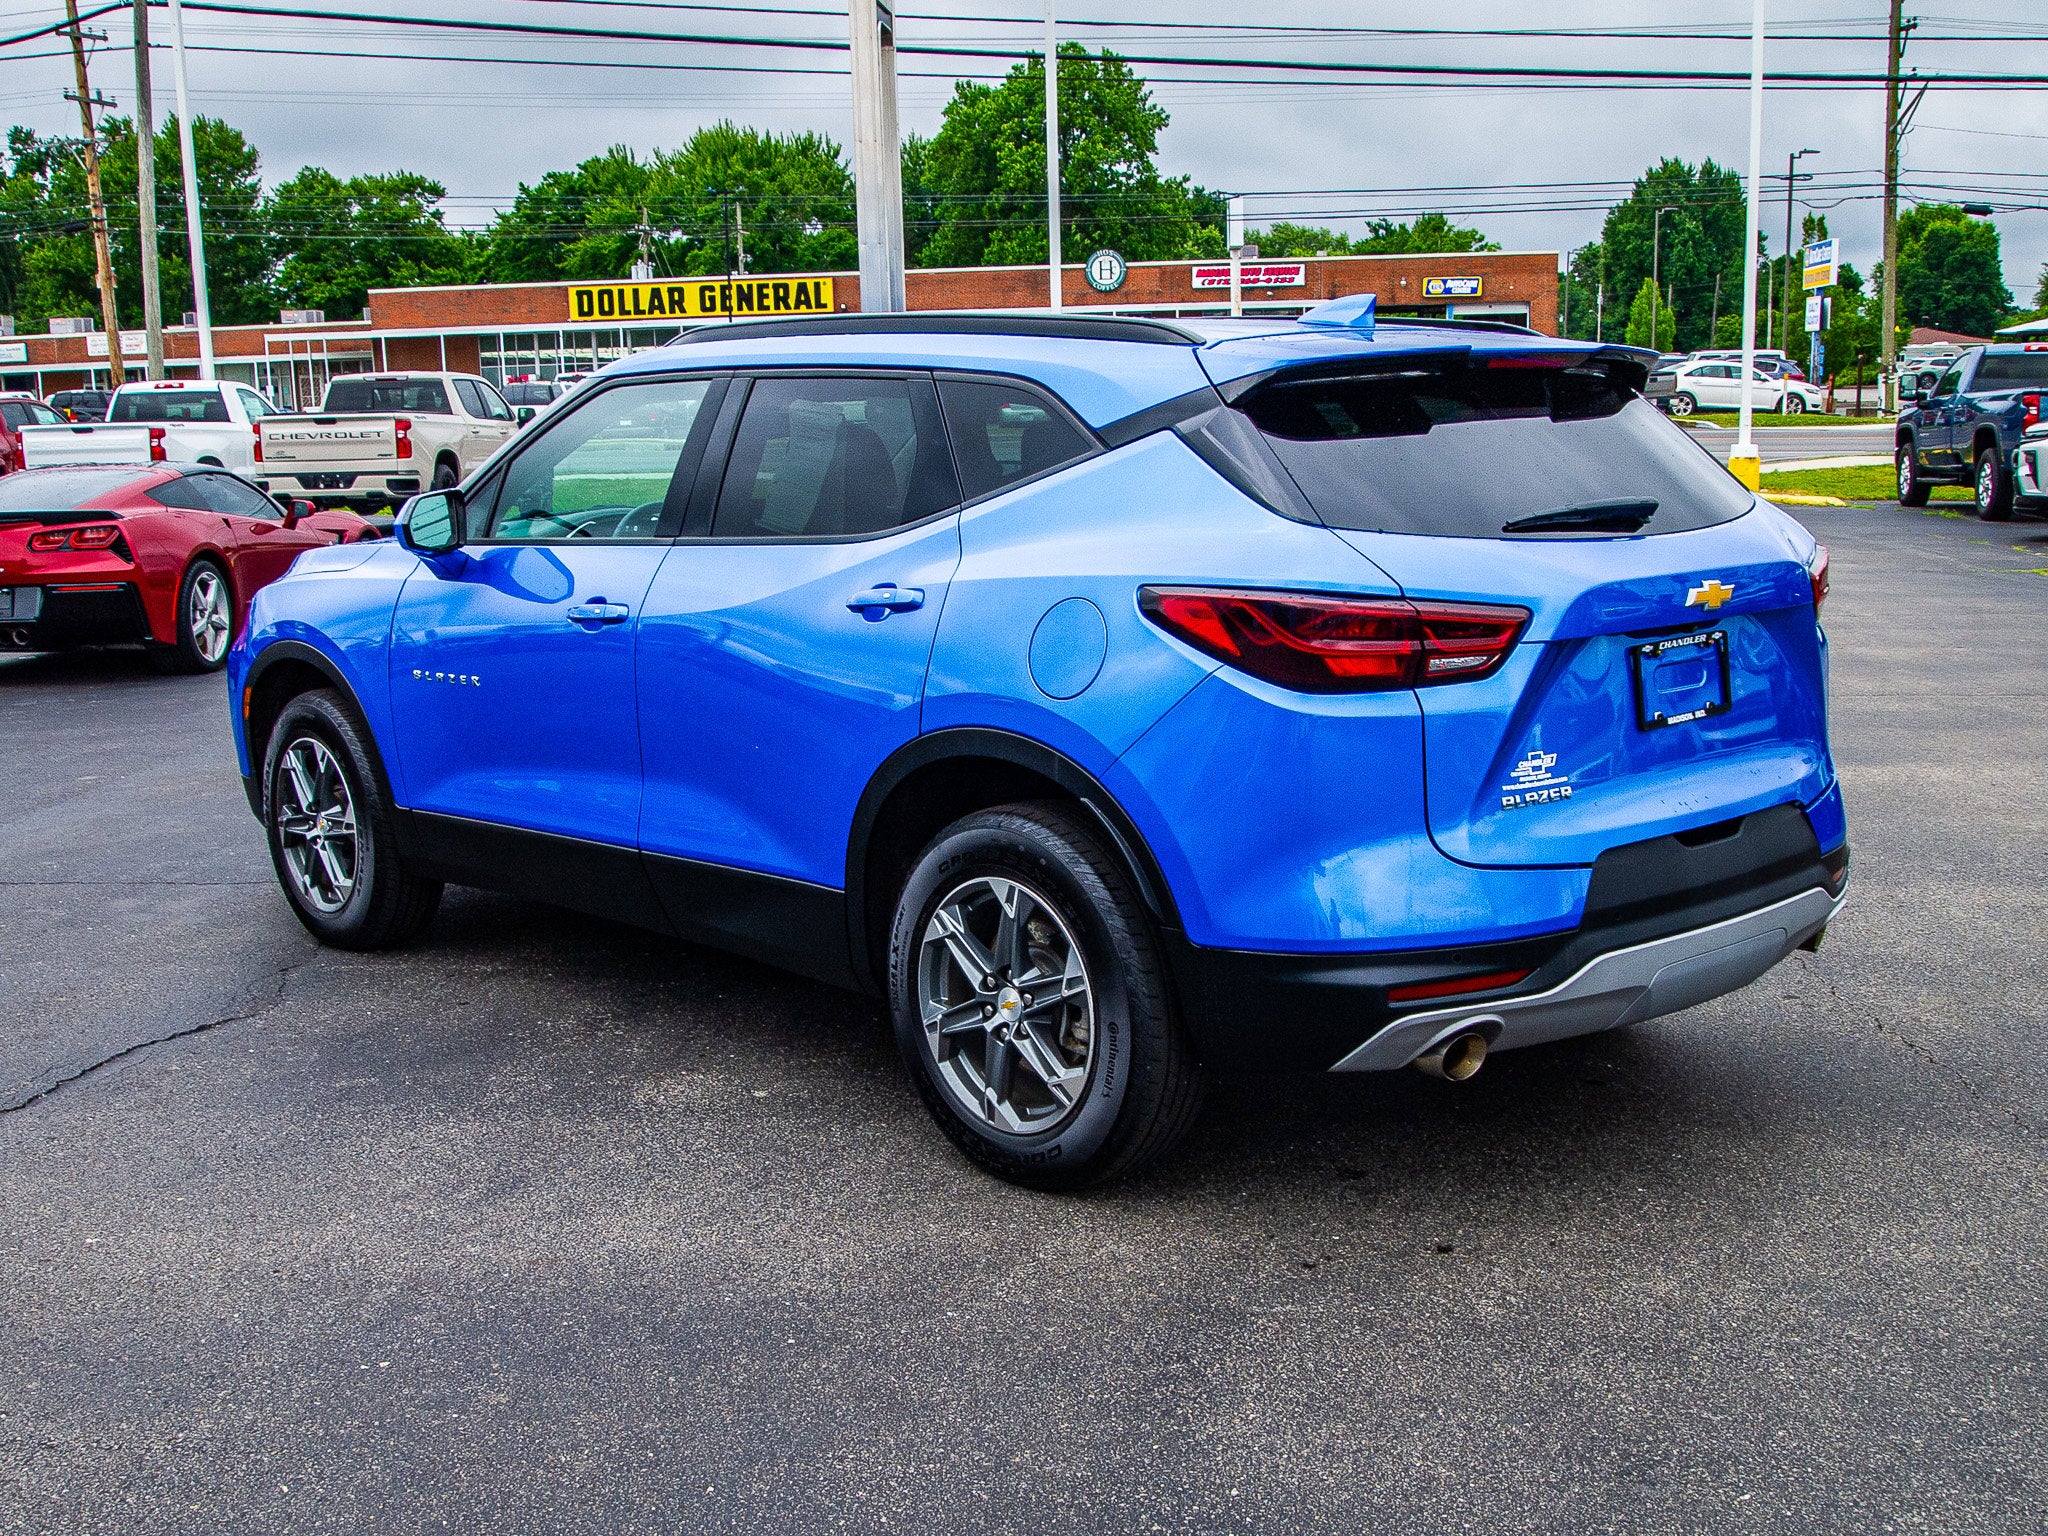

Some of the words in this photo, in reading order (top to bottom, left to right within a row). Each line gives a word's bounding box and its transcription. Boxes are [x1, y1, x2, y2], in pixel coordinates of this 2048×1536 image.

[1196, 268, 1230, 278] MADISO
[575, 286, 688, 317] DOLLAR
[699, 281, 828, 313] GENERAL
[268, 431, 386, 441] CHEVROLET
[1659, 634, 1707, 650] CHANDLER
[412, 669, 481, 687] BLAZER
[1501, 786, 1573, 810] BLAZER
[1102, 1021, 1120, 1092] Continental
